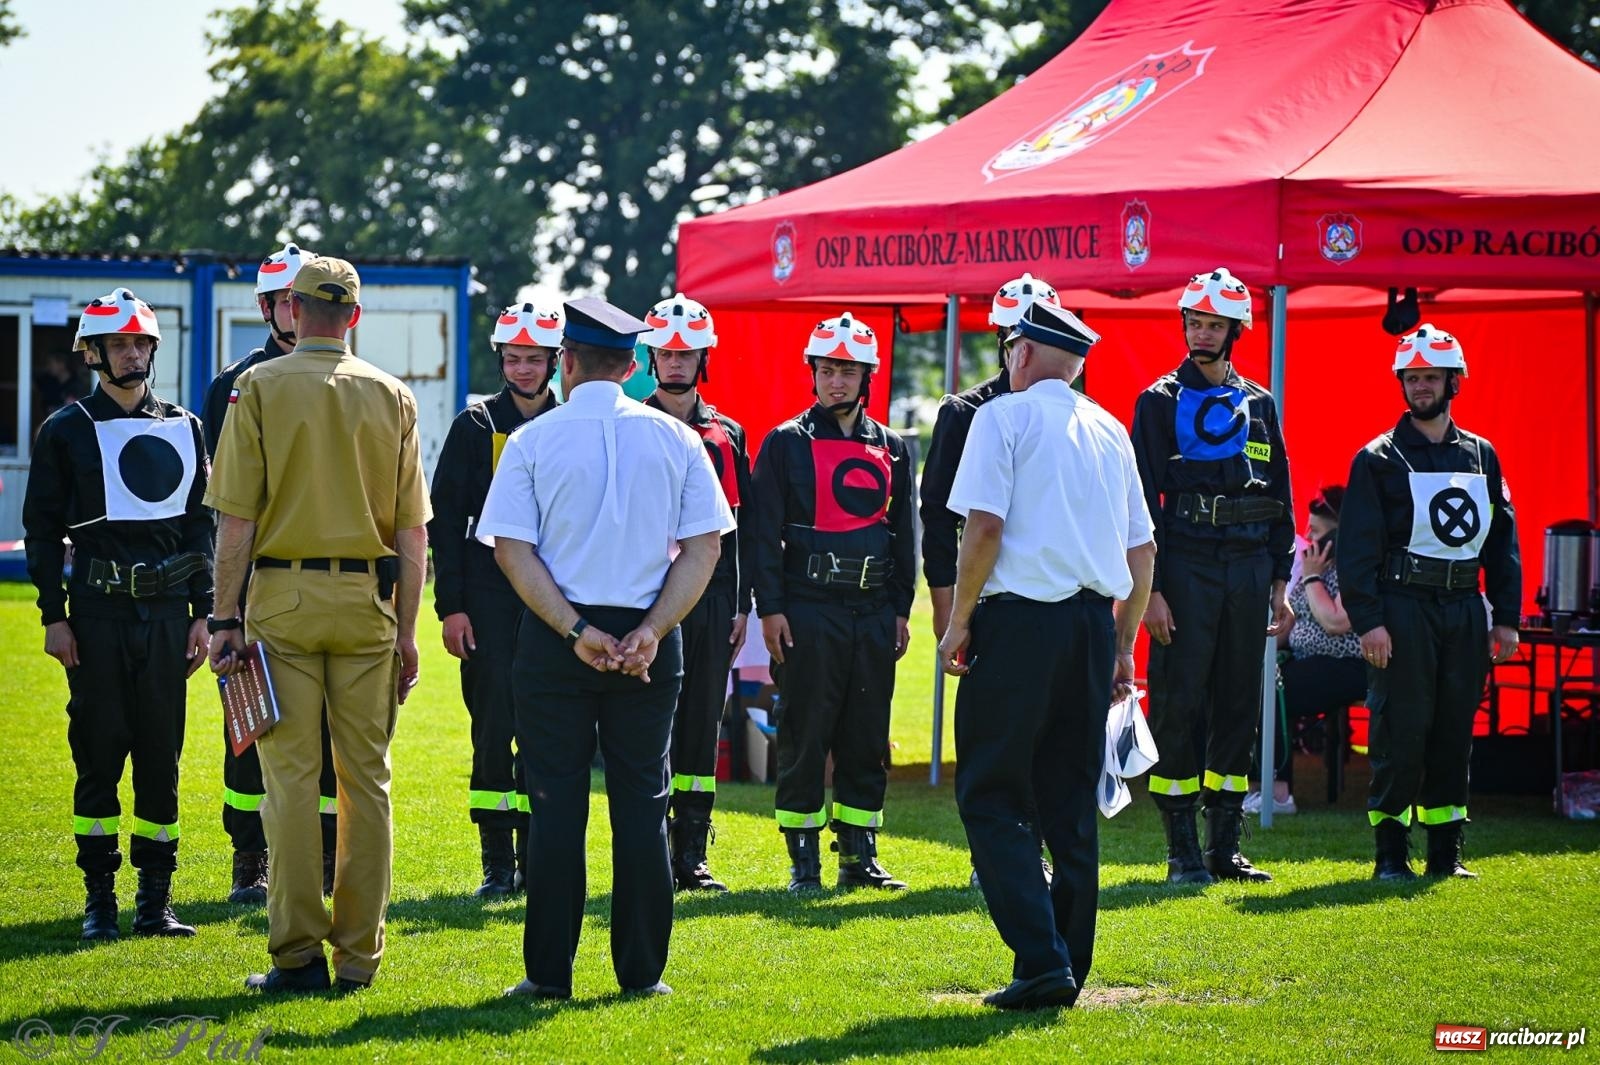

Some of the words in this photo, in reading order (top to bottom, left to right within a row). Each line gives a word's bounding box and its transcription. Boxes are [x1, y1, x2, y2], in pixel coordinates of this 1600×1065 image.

[816, 236, 851, 269] OSP
[855, 224, 1101, 268] RACIBÓRZ-MARKOWICE
[1402, 228, 1463, 254] OSP
